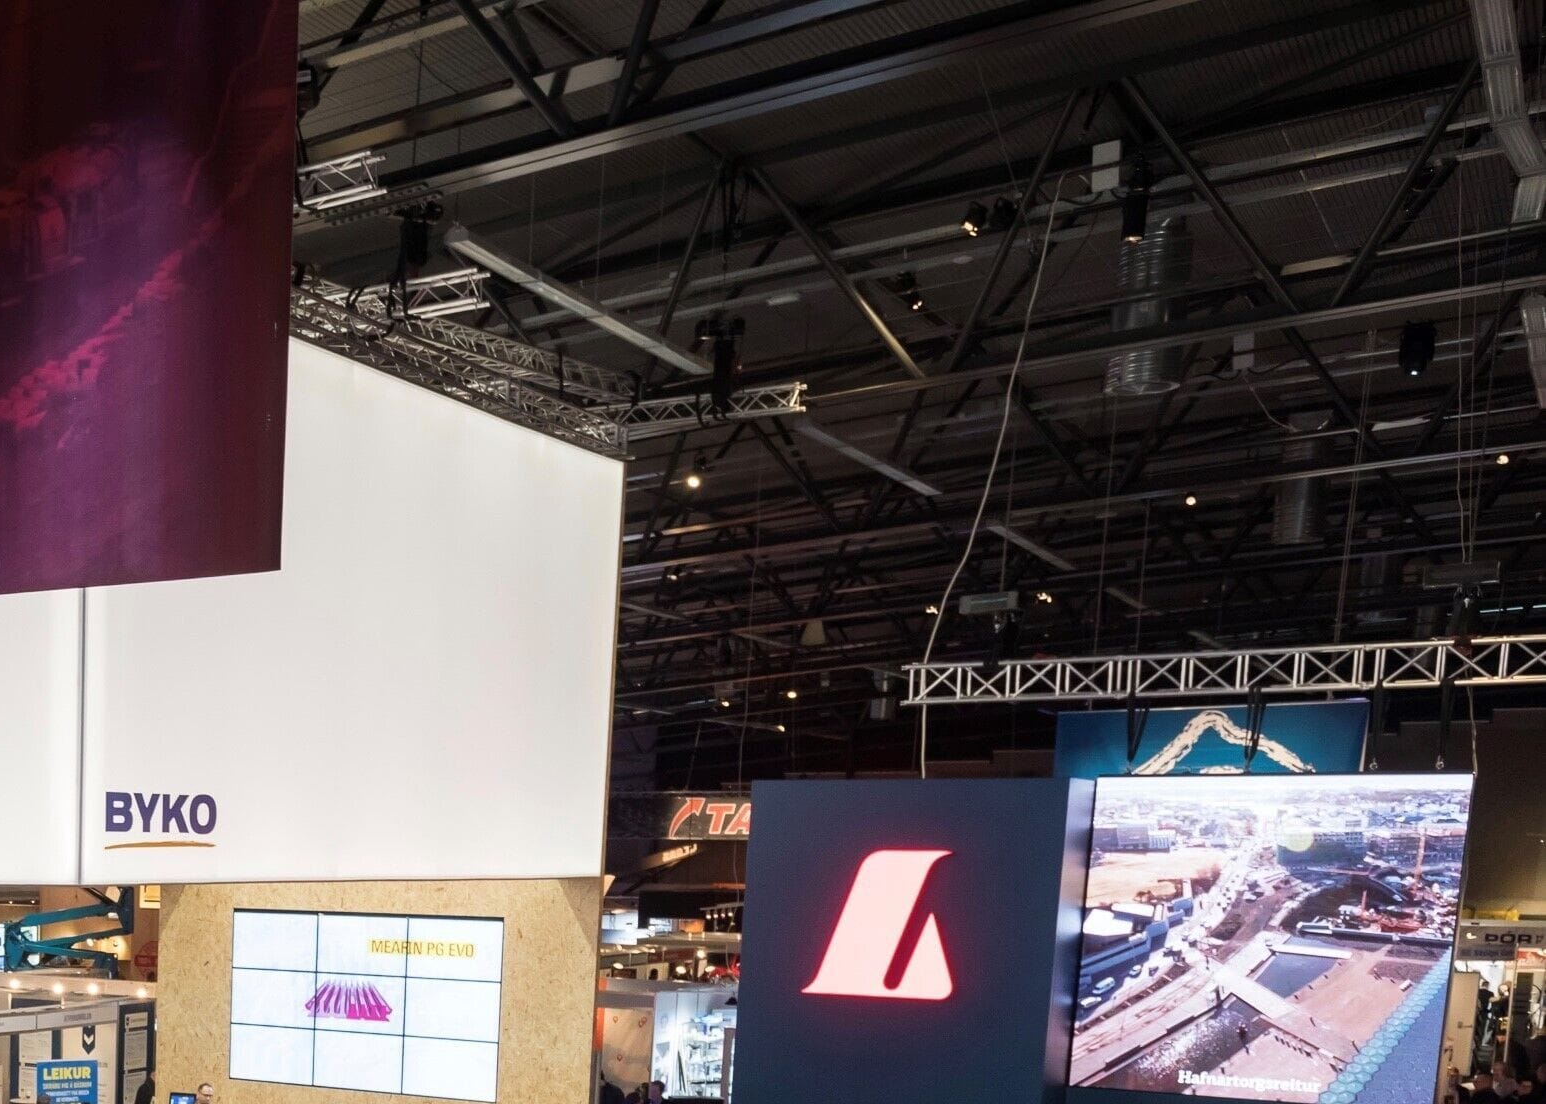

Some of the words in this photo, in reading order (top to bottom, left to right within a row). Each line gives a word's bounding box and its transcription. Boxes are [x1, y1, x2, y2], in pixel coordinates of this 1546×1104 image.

[104, 791, 217, 835] BYKO
[371, 940, 423, 955] MEARIN
[427, 942, 445, 956] PG
[449, 943, 475, 958] EVO
[42, 1066, 92, 1081] LEIKUR
